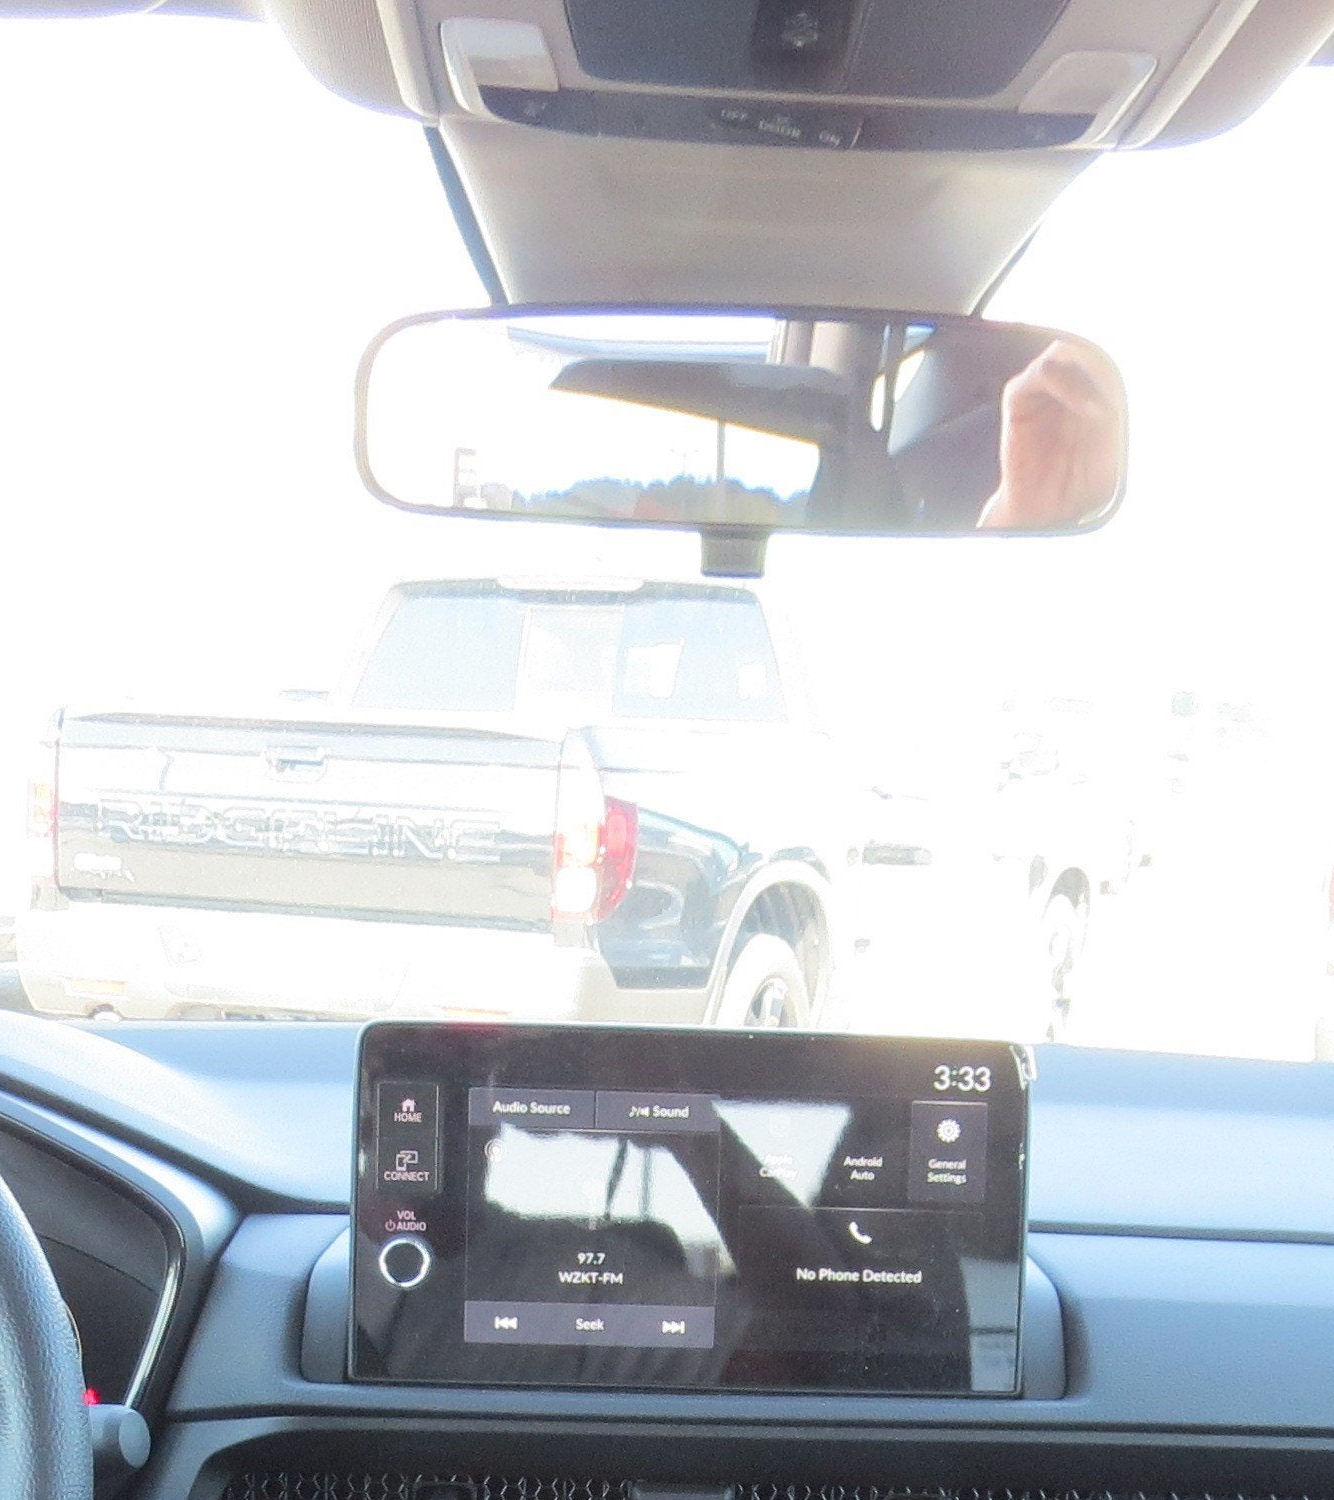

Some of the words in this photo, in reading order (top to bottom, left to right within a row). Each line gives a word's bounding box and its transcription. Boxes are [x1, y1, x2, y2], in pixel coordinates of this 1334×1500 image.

[933, 1065, 991, 1092] 3:33
[492, 1101, 528, 1114] Audio
[529, 1102, 571, 1115] Source
[652, 1105, 690, 1118] Sound
[394, 1112, 422, 1123] HOME
[765, 1154, 794, 1166] Apple
[843, 1156, 883, 1168] Android
[928, 1159, 967, 1171] General
[384, 1171, 429, 1182] CONNECT
[759, 1166, 797, 1181] CarPlay
[850, 1170, 875, 1181] Auto
[927, 1171, 967, 1185] Settings
[397, 1211, 416, 1221] VOL
[397, 1221, 427, 1232] AUDIO
[577, 1252, 606, 1265] 97.7
[558, 1271, 624, 1286] WZKT-FM
[796, 1267, 816, 1281] No
[819, 1268, 860, 1282] Phone
[862, 1269, 923, 1284] Detected
[575, 1318, 605, 1331] Seek
